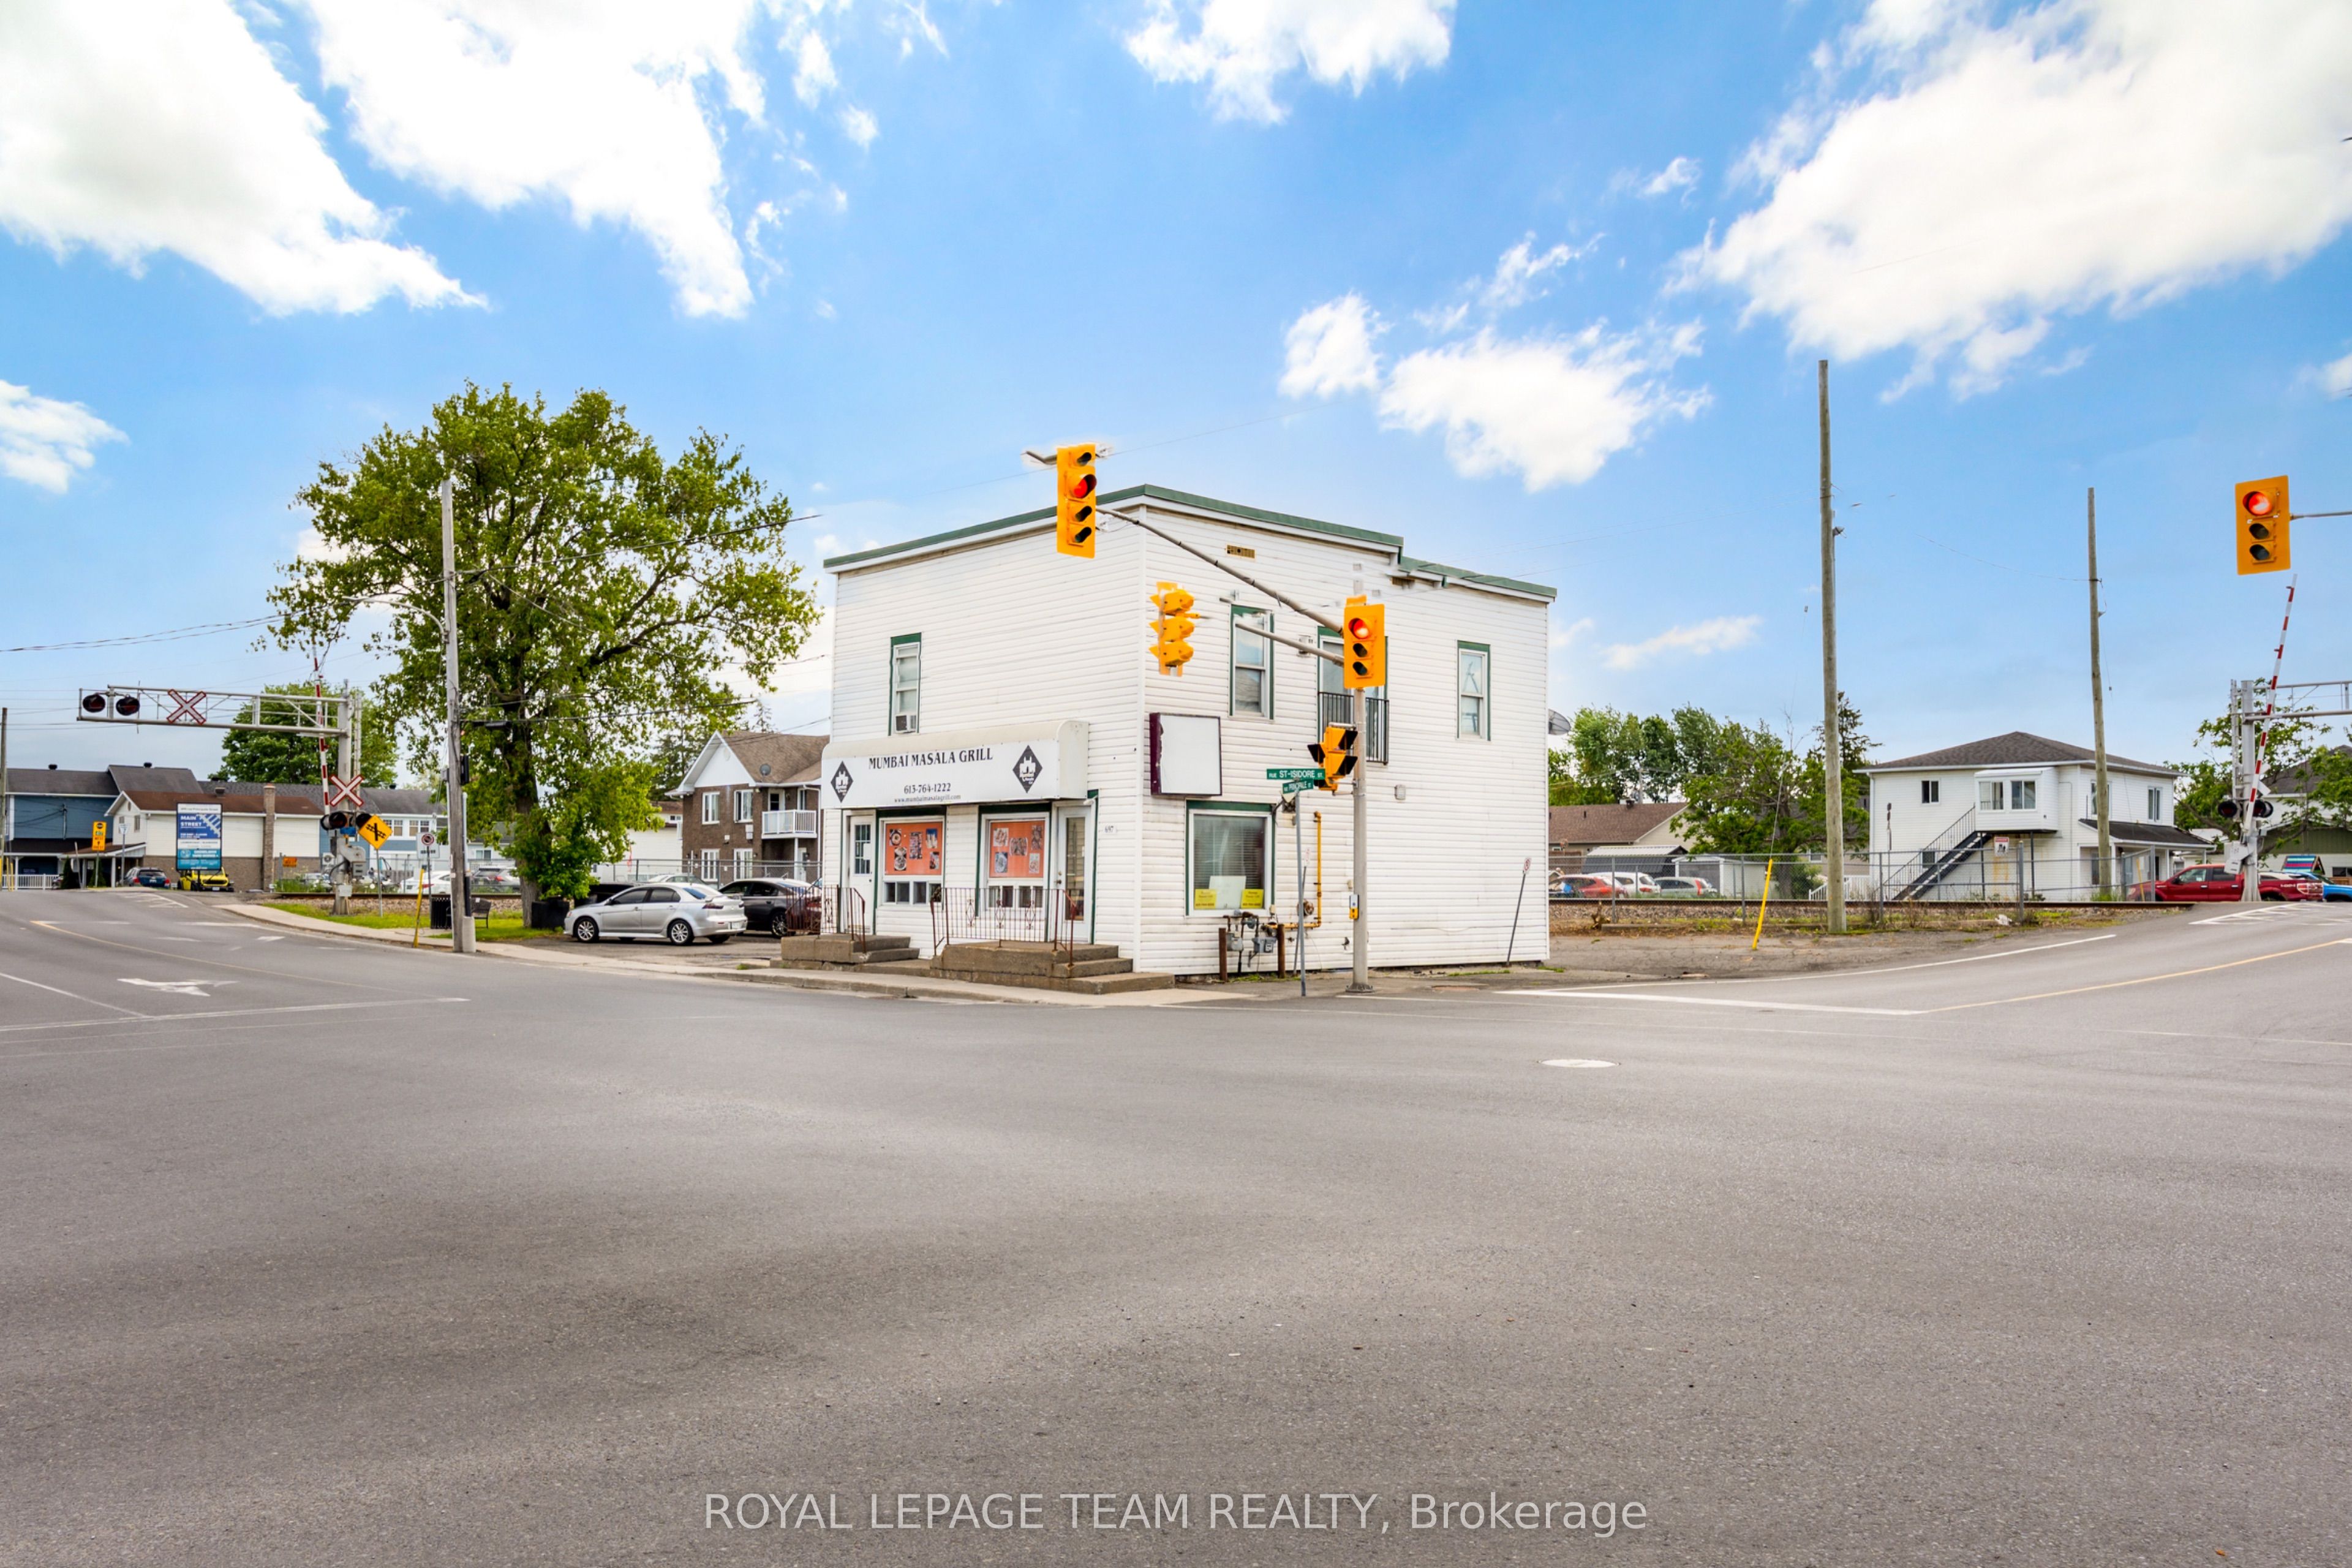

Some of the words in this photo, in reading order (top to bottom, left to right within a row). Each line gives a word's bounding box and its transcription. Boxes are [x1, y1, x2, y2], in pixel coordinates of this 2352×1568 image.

[869, 755, 908, 769] MUMBAI
[911, 752, 956, 766] MASALA
[959, 748, 993, 763] GRILL
[904, 783, 951, 794] 613-764-1222
